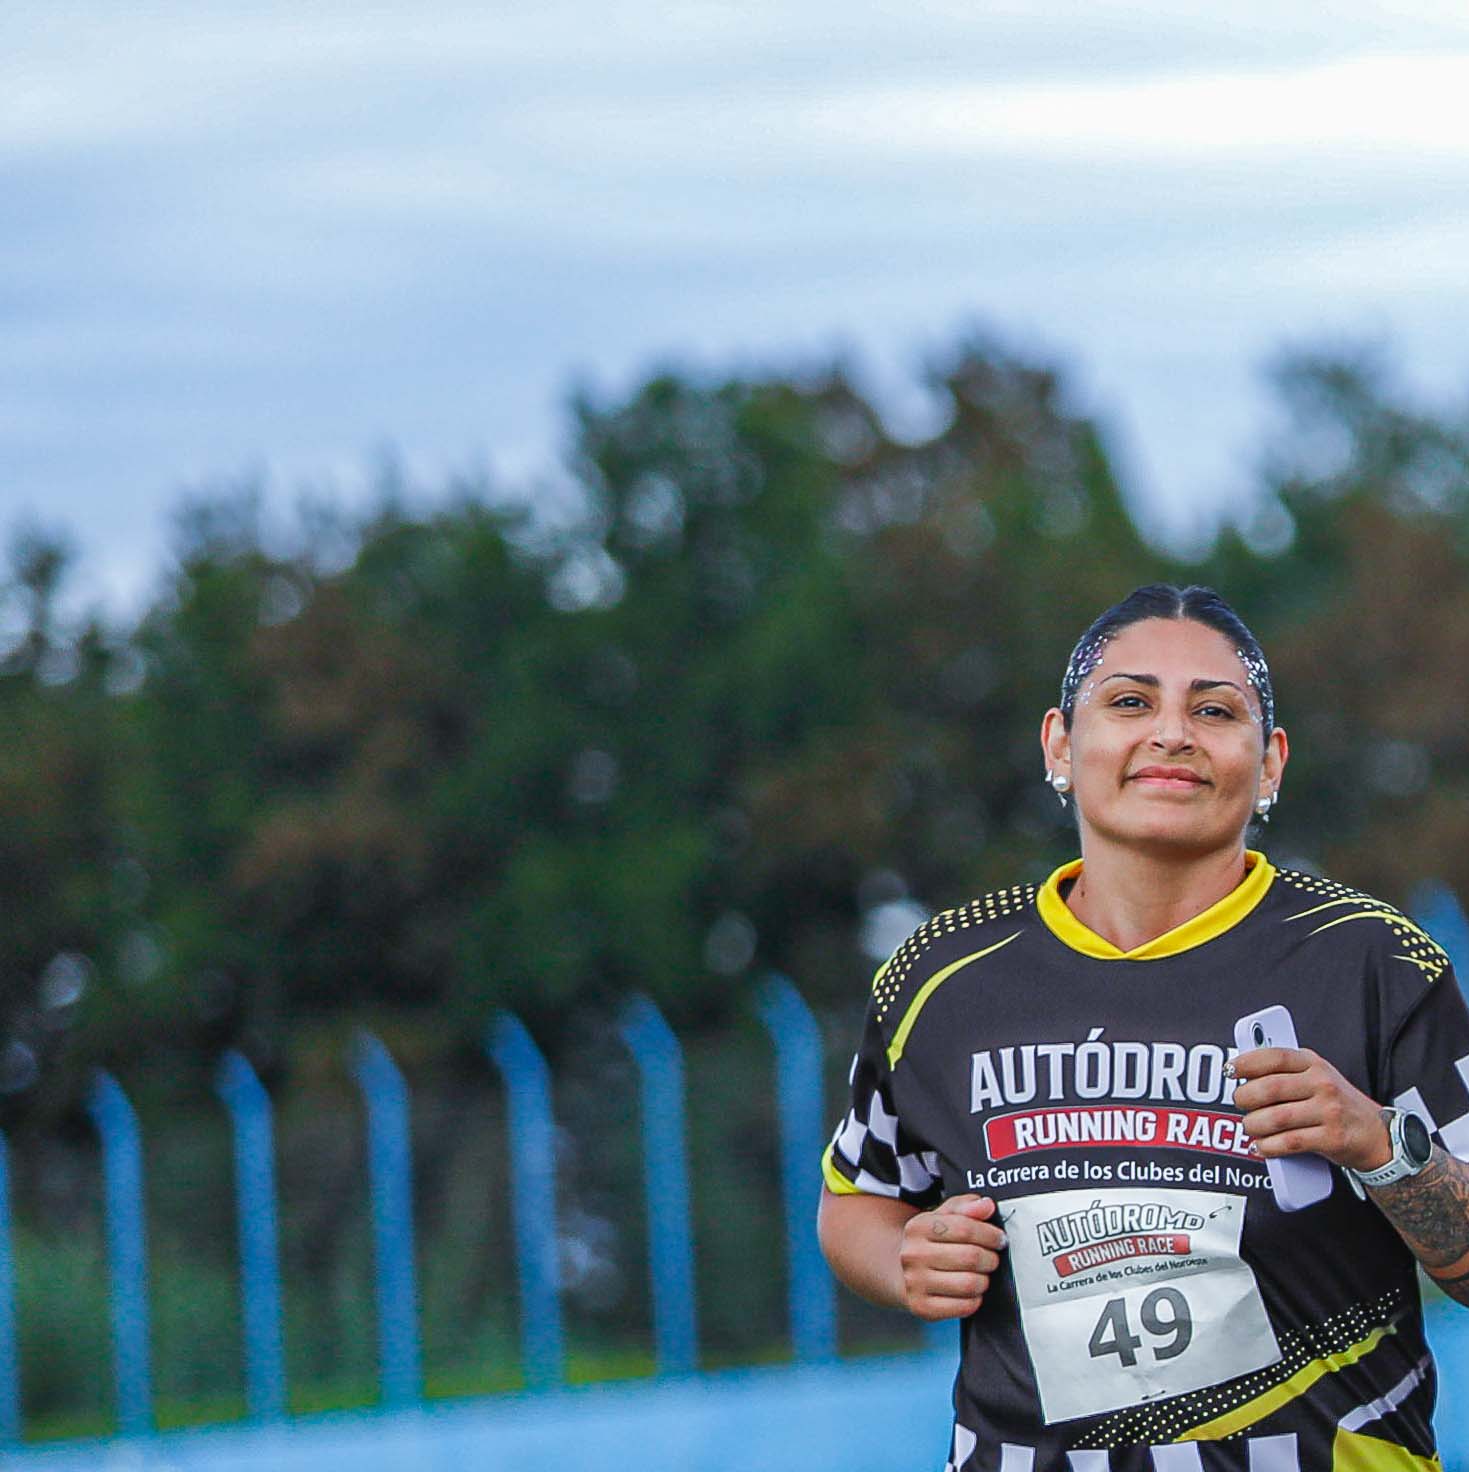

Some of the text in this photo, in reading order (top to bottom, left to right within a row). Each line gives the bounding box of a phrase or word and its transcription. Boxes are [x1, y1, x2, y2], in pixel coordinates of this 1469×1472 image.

[970, 1027, 1247, 1114] AUTÓDRO
[1013, 1110, 1250, 1155] RUNNING RACE
[967, 1160, 1273, 1189] La Carrera de los Clubes del Noro
[1036, 1199, 1205, 1257] AUTÓDROMO
[1068, 1237, 1175, 1271] RUNNING RACE
[1047, 1283, 1059, 1294] La
[1059, 1275, 1094, 1290] Carrera
[1096, 1271, 1108, 1282] de
[1109, 1269, 1123, 1280] los
[1124, 1264, 1153, 1277] Clubes
[1155, 1260, 1168, 1272] del
[1088, 1287, 1192, 1368] 49
